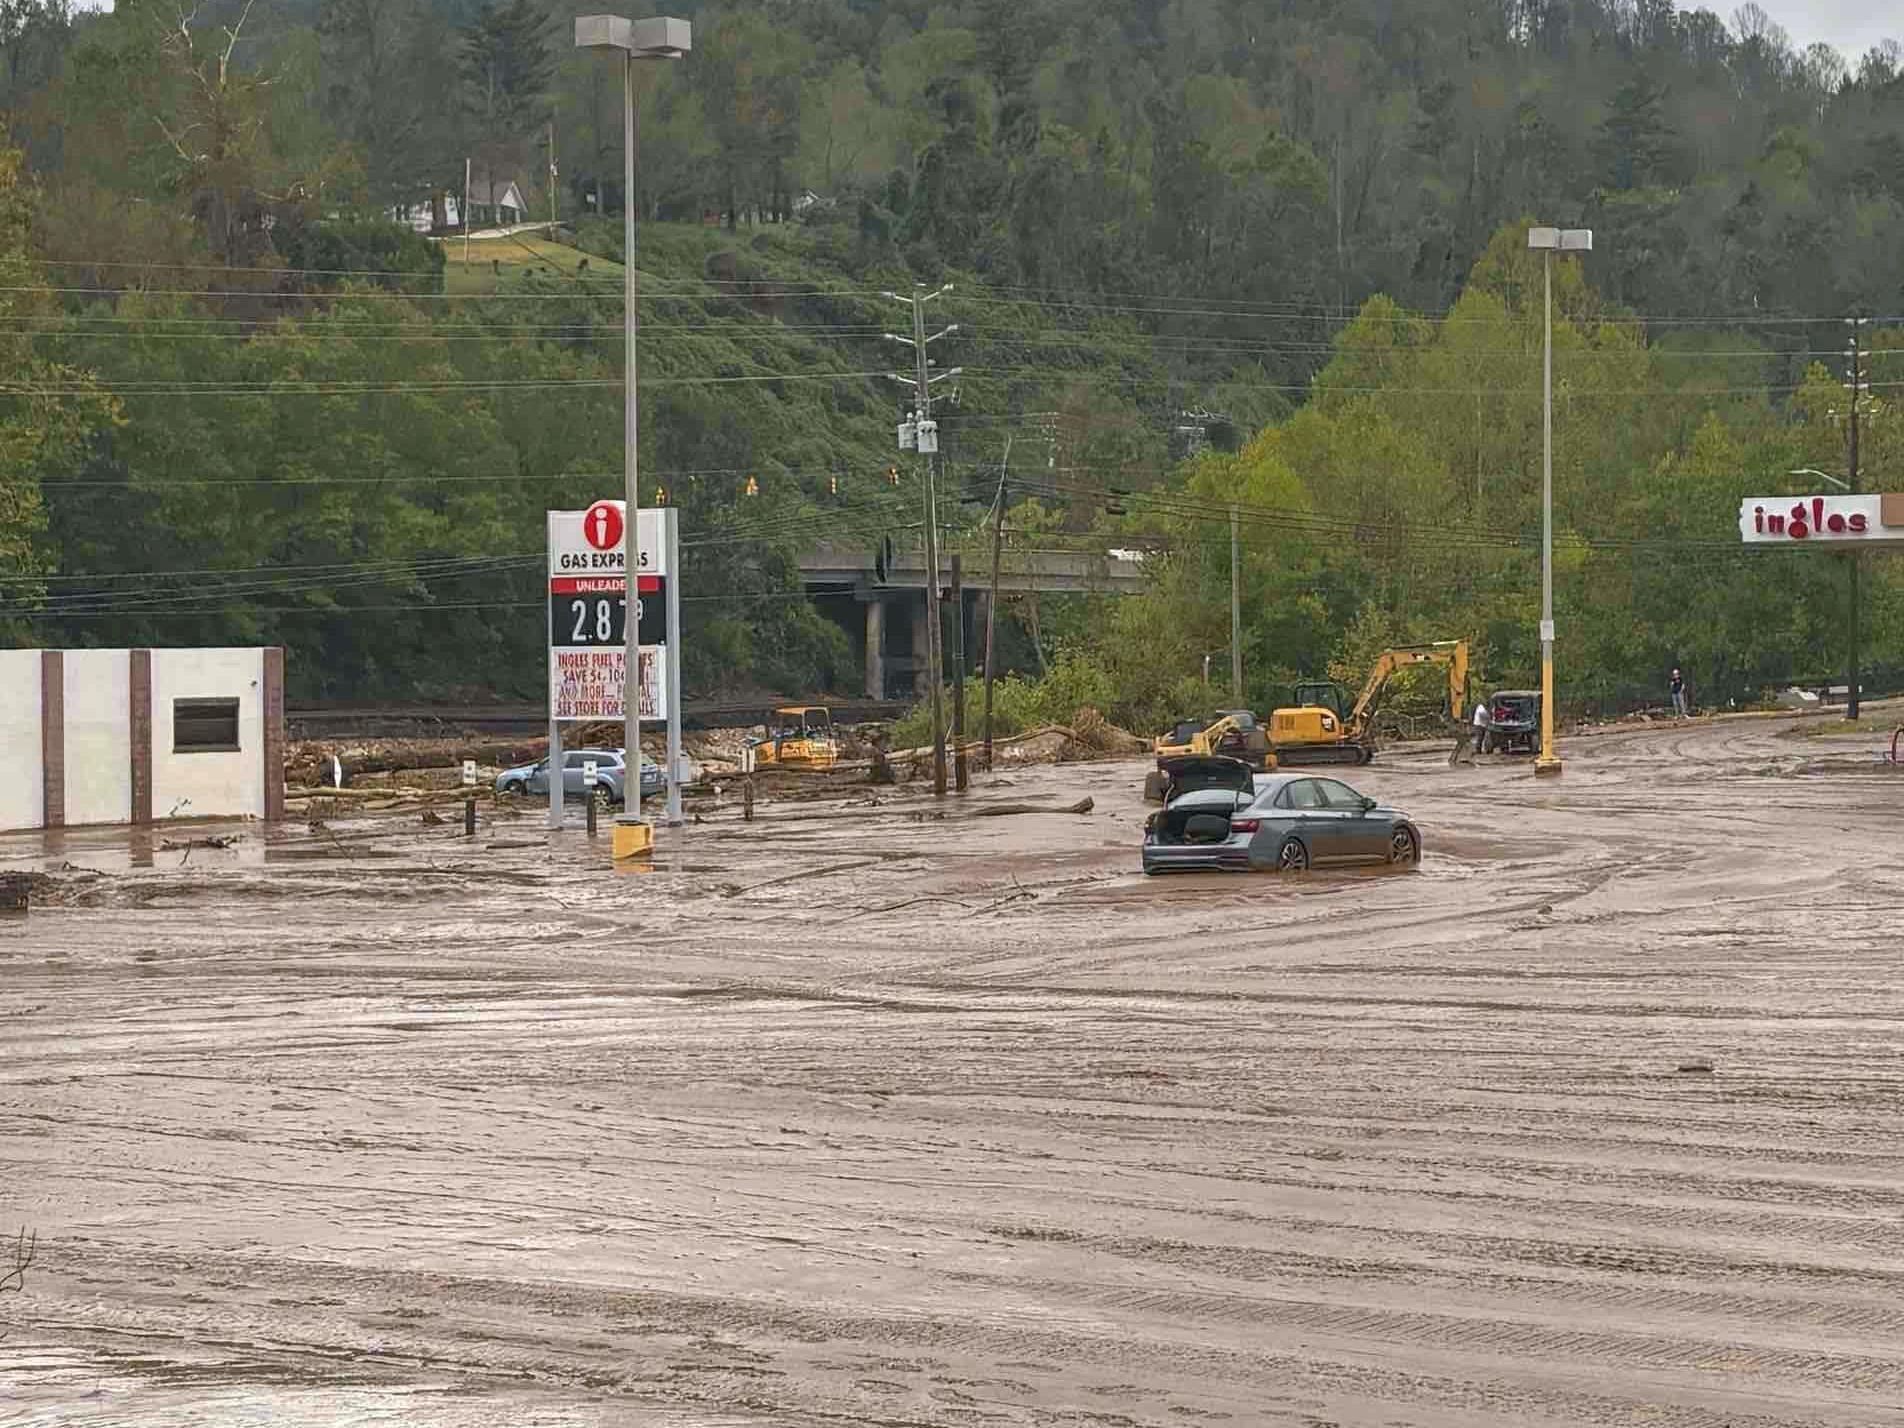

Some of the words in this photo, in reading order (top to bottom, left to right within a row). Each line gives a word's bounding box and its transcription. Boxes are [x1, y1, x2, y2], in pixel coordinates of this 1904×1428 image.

[1754, 497, 1867, 539] ingles
[561, 553, 588, 568] GAS
[592, 552, 649, 568] EXPRS
[576, 579, 627, 592] UNLEADE
